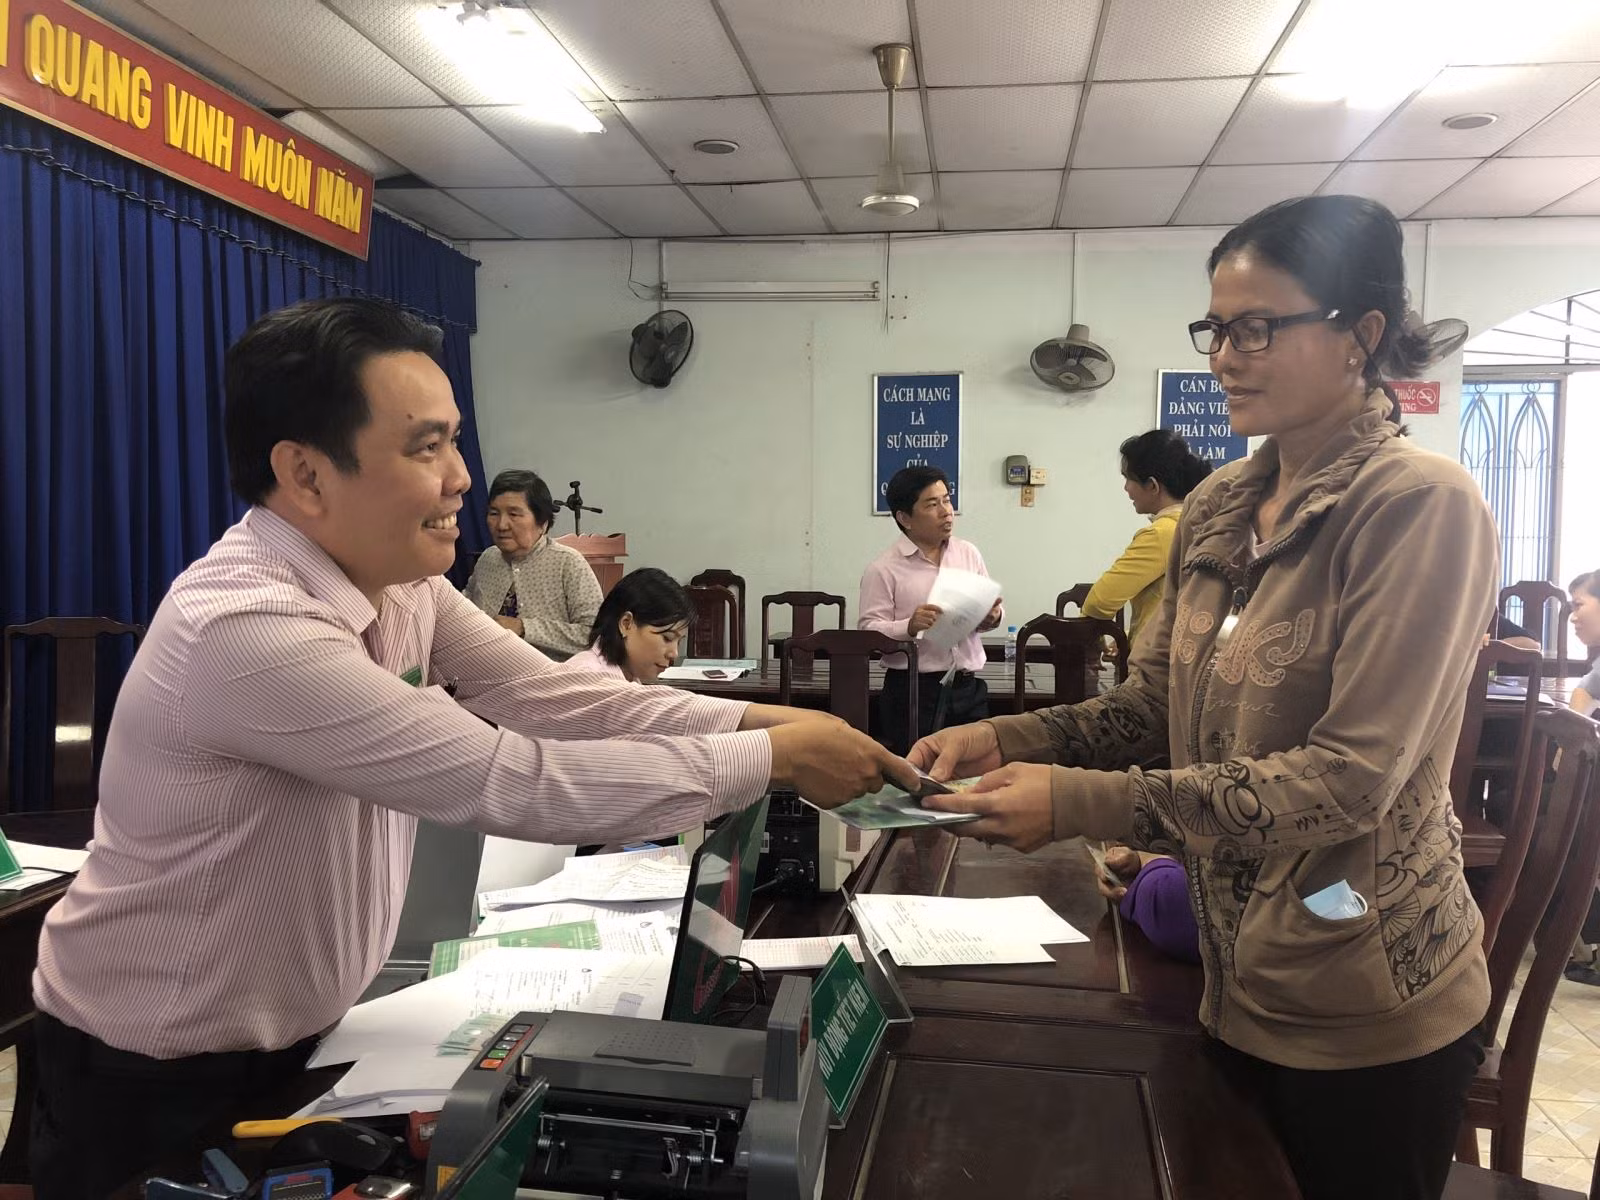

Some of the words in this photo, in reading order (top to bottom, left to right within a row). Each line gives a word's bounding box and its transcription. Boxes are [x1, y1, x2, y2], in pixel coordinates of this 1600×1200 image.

[25, 14, 152, 129] QUANG
[164, 83, 234, 172] VINH
[240, 125, 312, 209] MUÔN
[315, 167, 363, 233] NĂM
[1180, 376, 1207, 393] CÁN
[883, 385, 914, 402] CÁCH
[917, 387, 951, 405] MẠNG
[1168, 396, 1205, 415] ĐẢNG
[1208, 399, 1230, 415] VIÊ
[911, 408, 925, 425] LÀ
[1174, 418, 1205, 437] PHẢI
[1208, 420, 1232, 437] NÓI
[887, 432, 902, 451] SỰ
[904, 431, 948, 451] NGHIỆP
